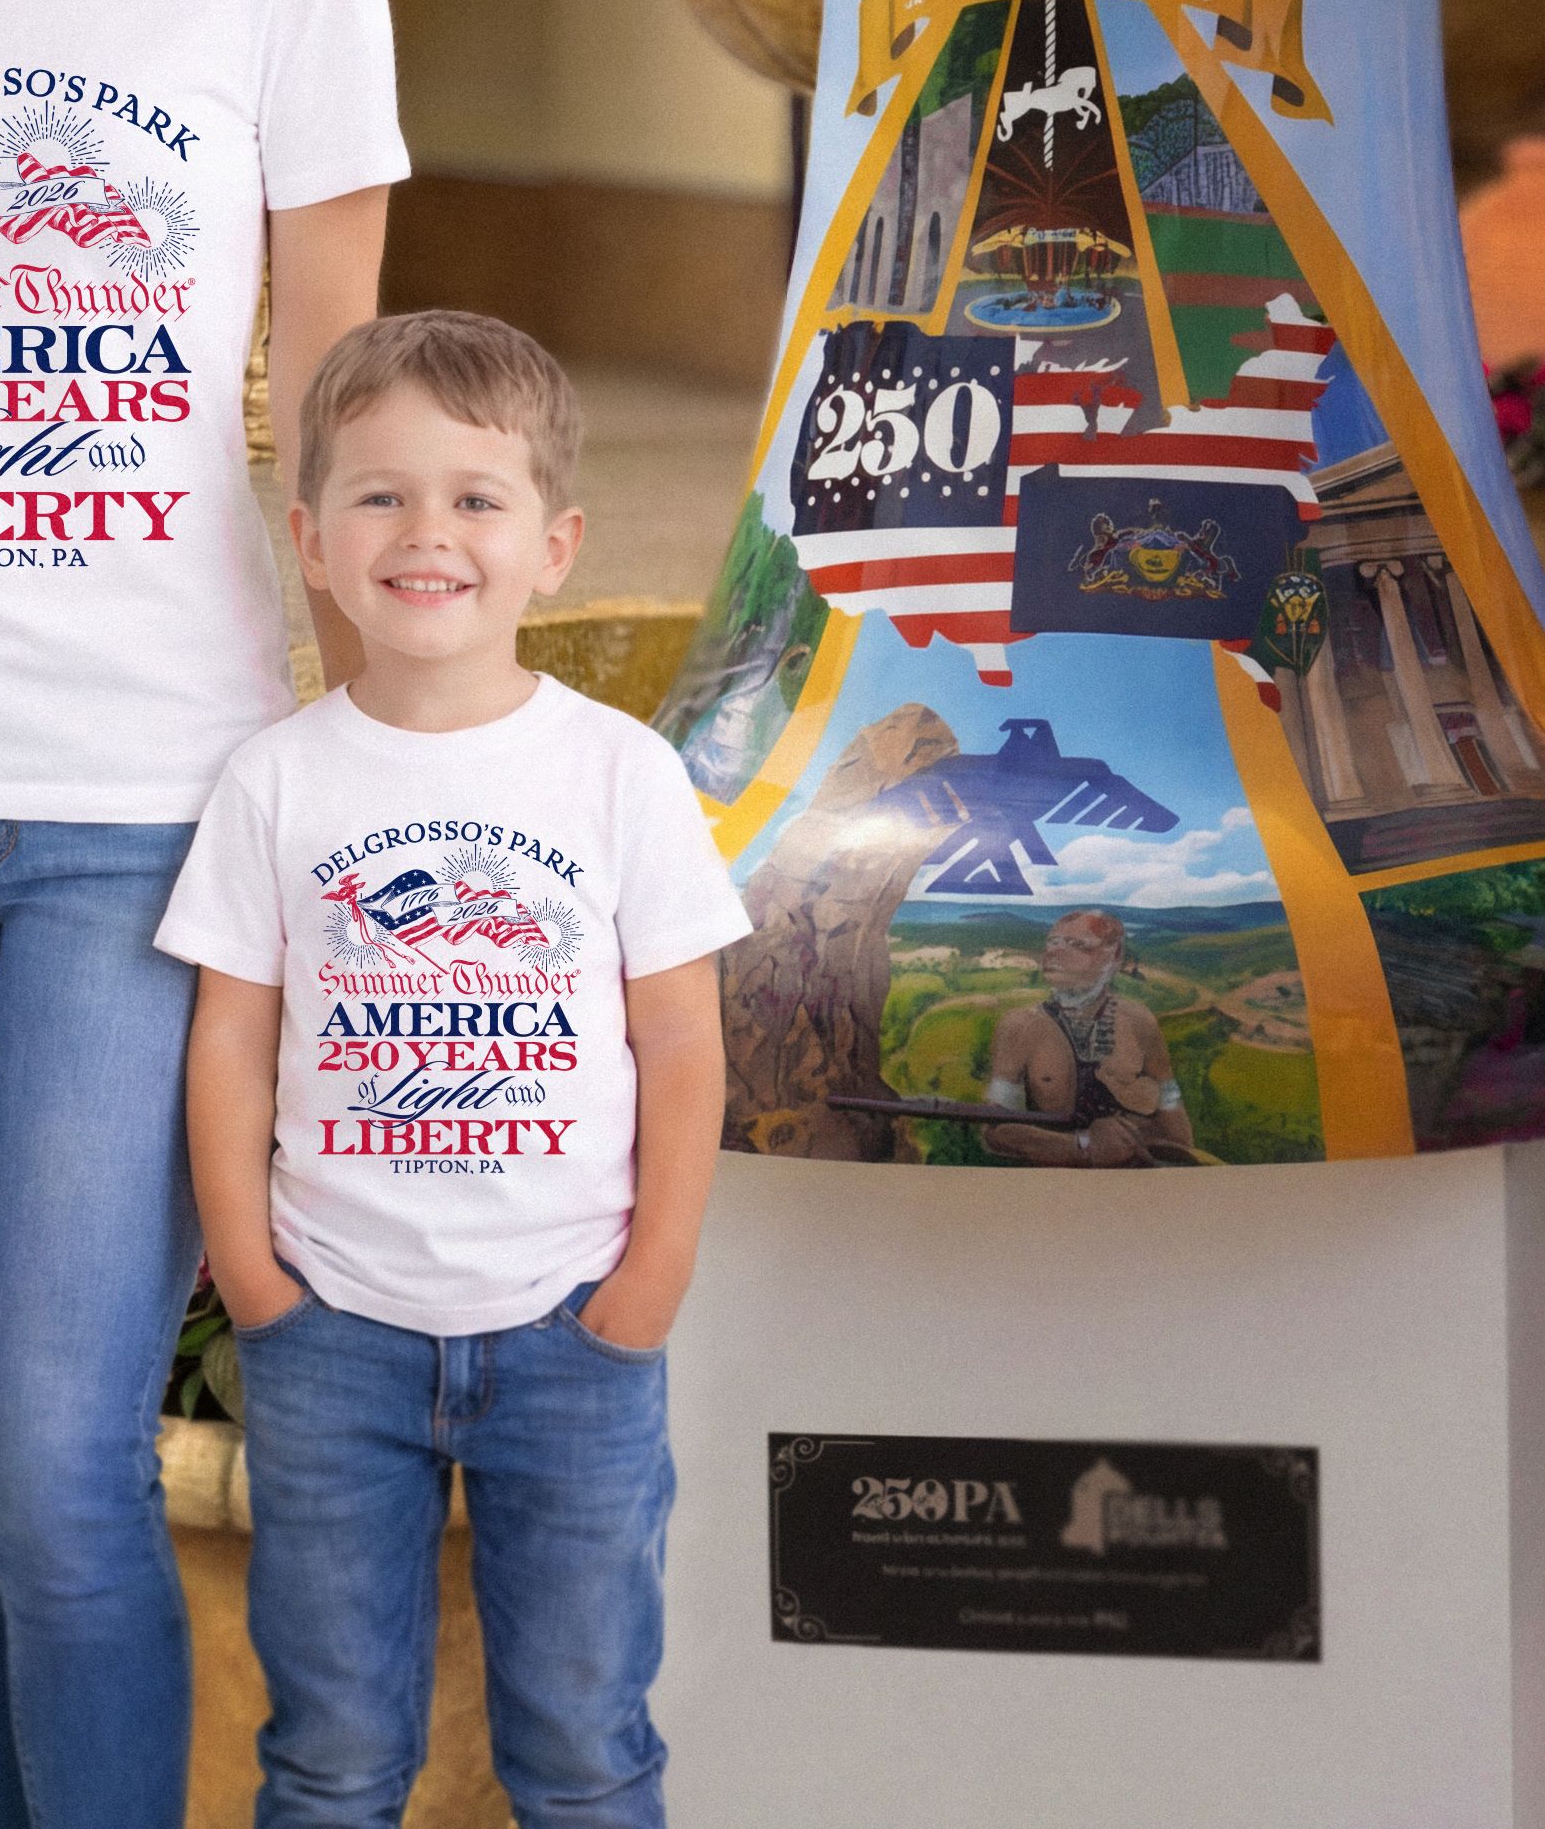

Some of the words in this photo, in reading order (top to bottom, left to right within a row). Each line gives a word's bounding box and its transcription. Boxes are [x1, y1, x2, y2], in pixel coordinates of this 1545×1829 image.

[92, 82, 201, 162] PARK
[8, 181, 82, 211] 2026
[807, 378, 1002, 481] 250
[88, 432, 146, 473] and
[52, 549, 88, 567] PA
[311, 820, 503, 887] DELGROSSO'S
[508, 830, 584, 887] PARK
[400, 888, 443, 912] 1776
[452, 900, 499, 920] 2026
[318, 960, 445, 999] Summer
[317, 1002, 578, 1037] AMERICA
[318, 1041, 399, 1071] 250
[404, 1041, 577, 1071] YEARS
[347, 1061, 515, 1129] Light
[358, 1073, 380, 1104] of
[505, 1079, 547, 1108] and
[318, 1120, 577, 1155] LIBERTY
[390, 1159, 473, 1175] TIPTON,
[480, 1160, 505, 1174] PA
